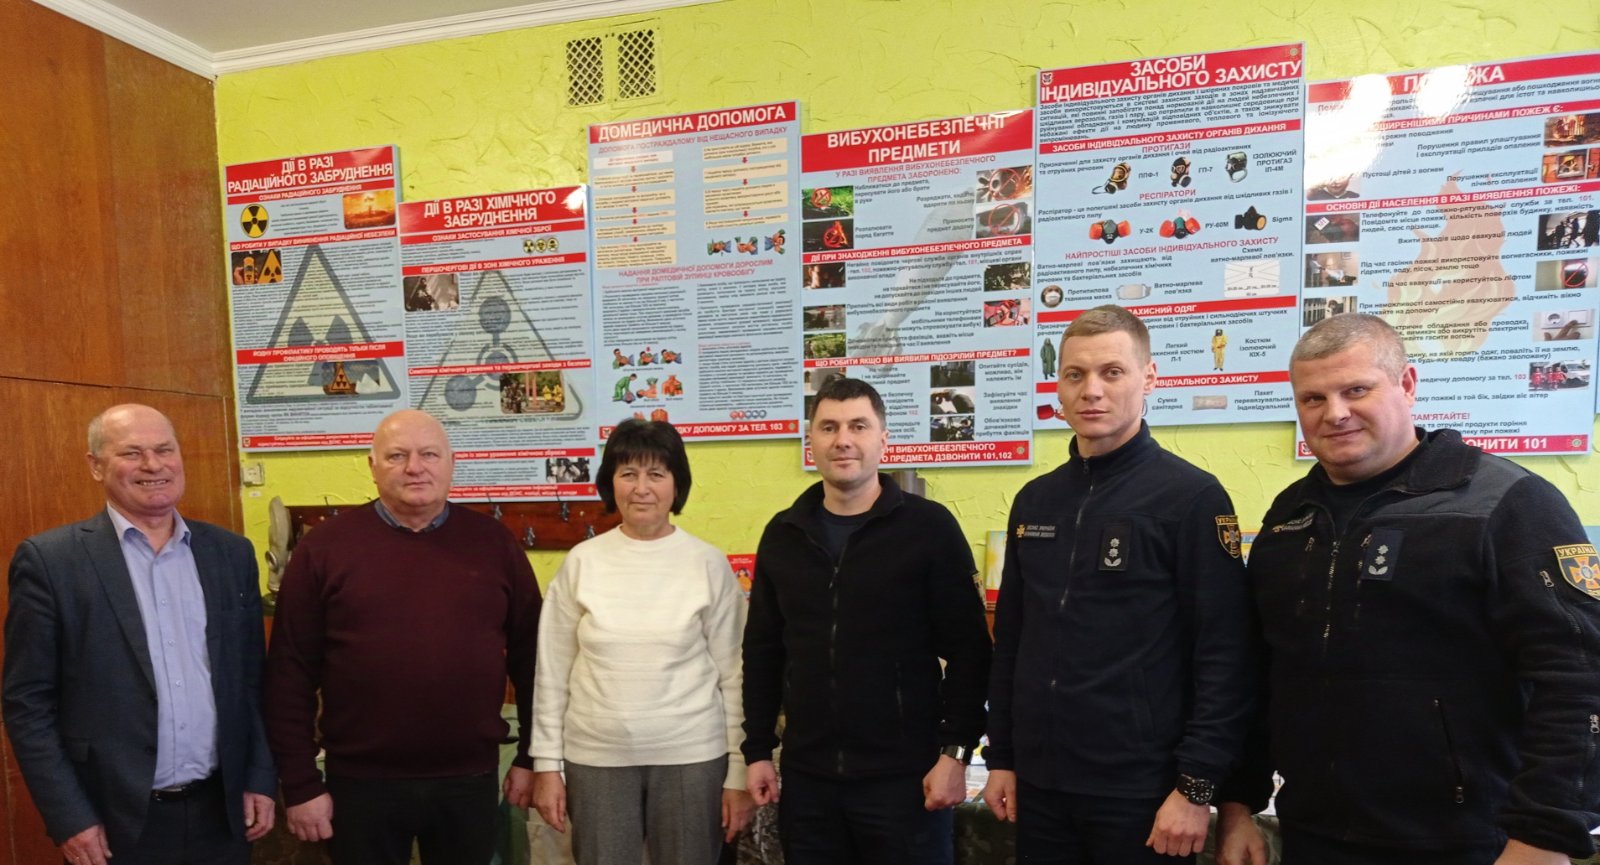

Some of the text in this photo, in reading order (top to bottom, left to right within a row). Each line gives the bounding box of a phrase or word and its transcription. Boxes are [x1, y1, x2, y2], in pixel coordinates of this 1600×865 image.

[1130, 55, 1206, 77] ЗАСОБИ
[1040, 60, 1302, 102] ІНДИВІДУАЛЬНОГО ЗАХИСТУ
[1403, 65, 1505, 92] ПЖА
[599, 106, 786, 141] ДОМЕДИЧНА ДОПОМОГА
[1448, 112, 1510, 124] ПРИЧИНАМИ
[1512, 106, 1550, 116] ПОЖЕЖ
[827, 116, 1005, 148] ВИБУХОНЕБЕЗПЕЧНІ
[1052, 124, 1286, 152] ЗАСОБИ ІНДИВІДУАЛЬНОГО ЗАХИСТУ ОРГАНІВ ДИХАННЯ
[868, 140, 961, 163] ПРЕДМЕТИ
[1142, 142, 1190, 153] ПРОТИГАЗИ
[282, 156, 333, 175] ДІЇ В РАЗІ
[1257, 158, 1292, 166] ПРОТИГАЗ
[228, 162, 393, 193] РАДІАЦІЙНОГО ЗАБРУДНЕННЯ
[1140, 189, 1196, 200] РЕСПІРАТОРИ
[1326, 202, 1367, 212] ОСНОВНІ
[1368, 200, 1380, 209] ДІЇ
[1382, 196, 1438, 208] НАСЕЛЕННЯ
[1472, 190, 1534, 200] ВИЯВЛЕННЯ
[1536, 185, 1581, 196] ПОЖЕЖІ:
[424, 191, 556, 218] ДІЇ В РАЗІ ХІМІЧНОГО
[444, 208, 537, 228] ЗАБРУДНЕННЯ
[891, 242, 980, 255] ВИБУХОНЕБЕЗПЕЧНОГО
[981, 238, 1022, 248] ПРЕДМЕТА
[1065, 237, 1278, 260] НАЙПРОСТІШІ ЗАСОБИ ІНДИВІДУАЛЬНОГО ЗАХИСТУ
[1174, 305, 1197, 313] ОДЯГ
[976, 350, 1017, 359] ПРЕДМЕТ?
[1156, 377, 1217, 387] ВІДУАЛЬНОГО
[693, 425, 737, 434] ДОПОМОГУ
[896, 443, 995, 453] ВИБУХОНЕБЕЗПЕЧНОГО
[1465, 438, 1547, 449] ОНИТИ 101
[890, 454, 933, 462] ПРЕДМЕТА
[935, 453, 980, 461] ДЗВОНИТИ
[1558, 546, 1595, 557] УКРАЇНА
